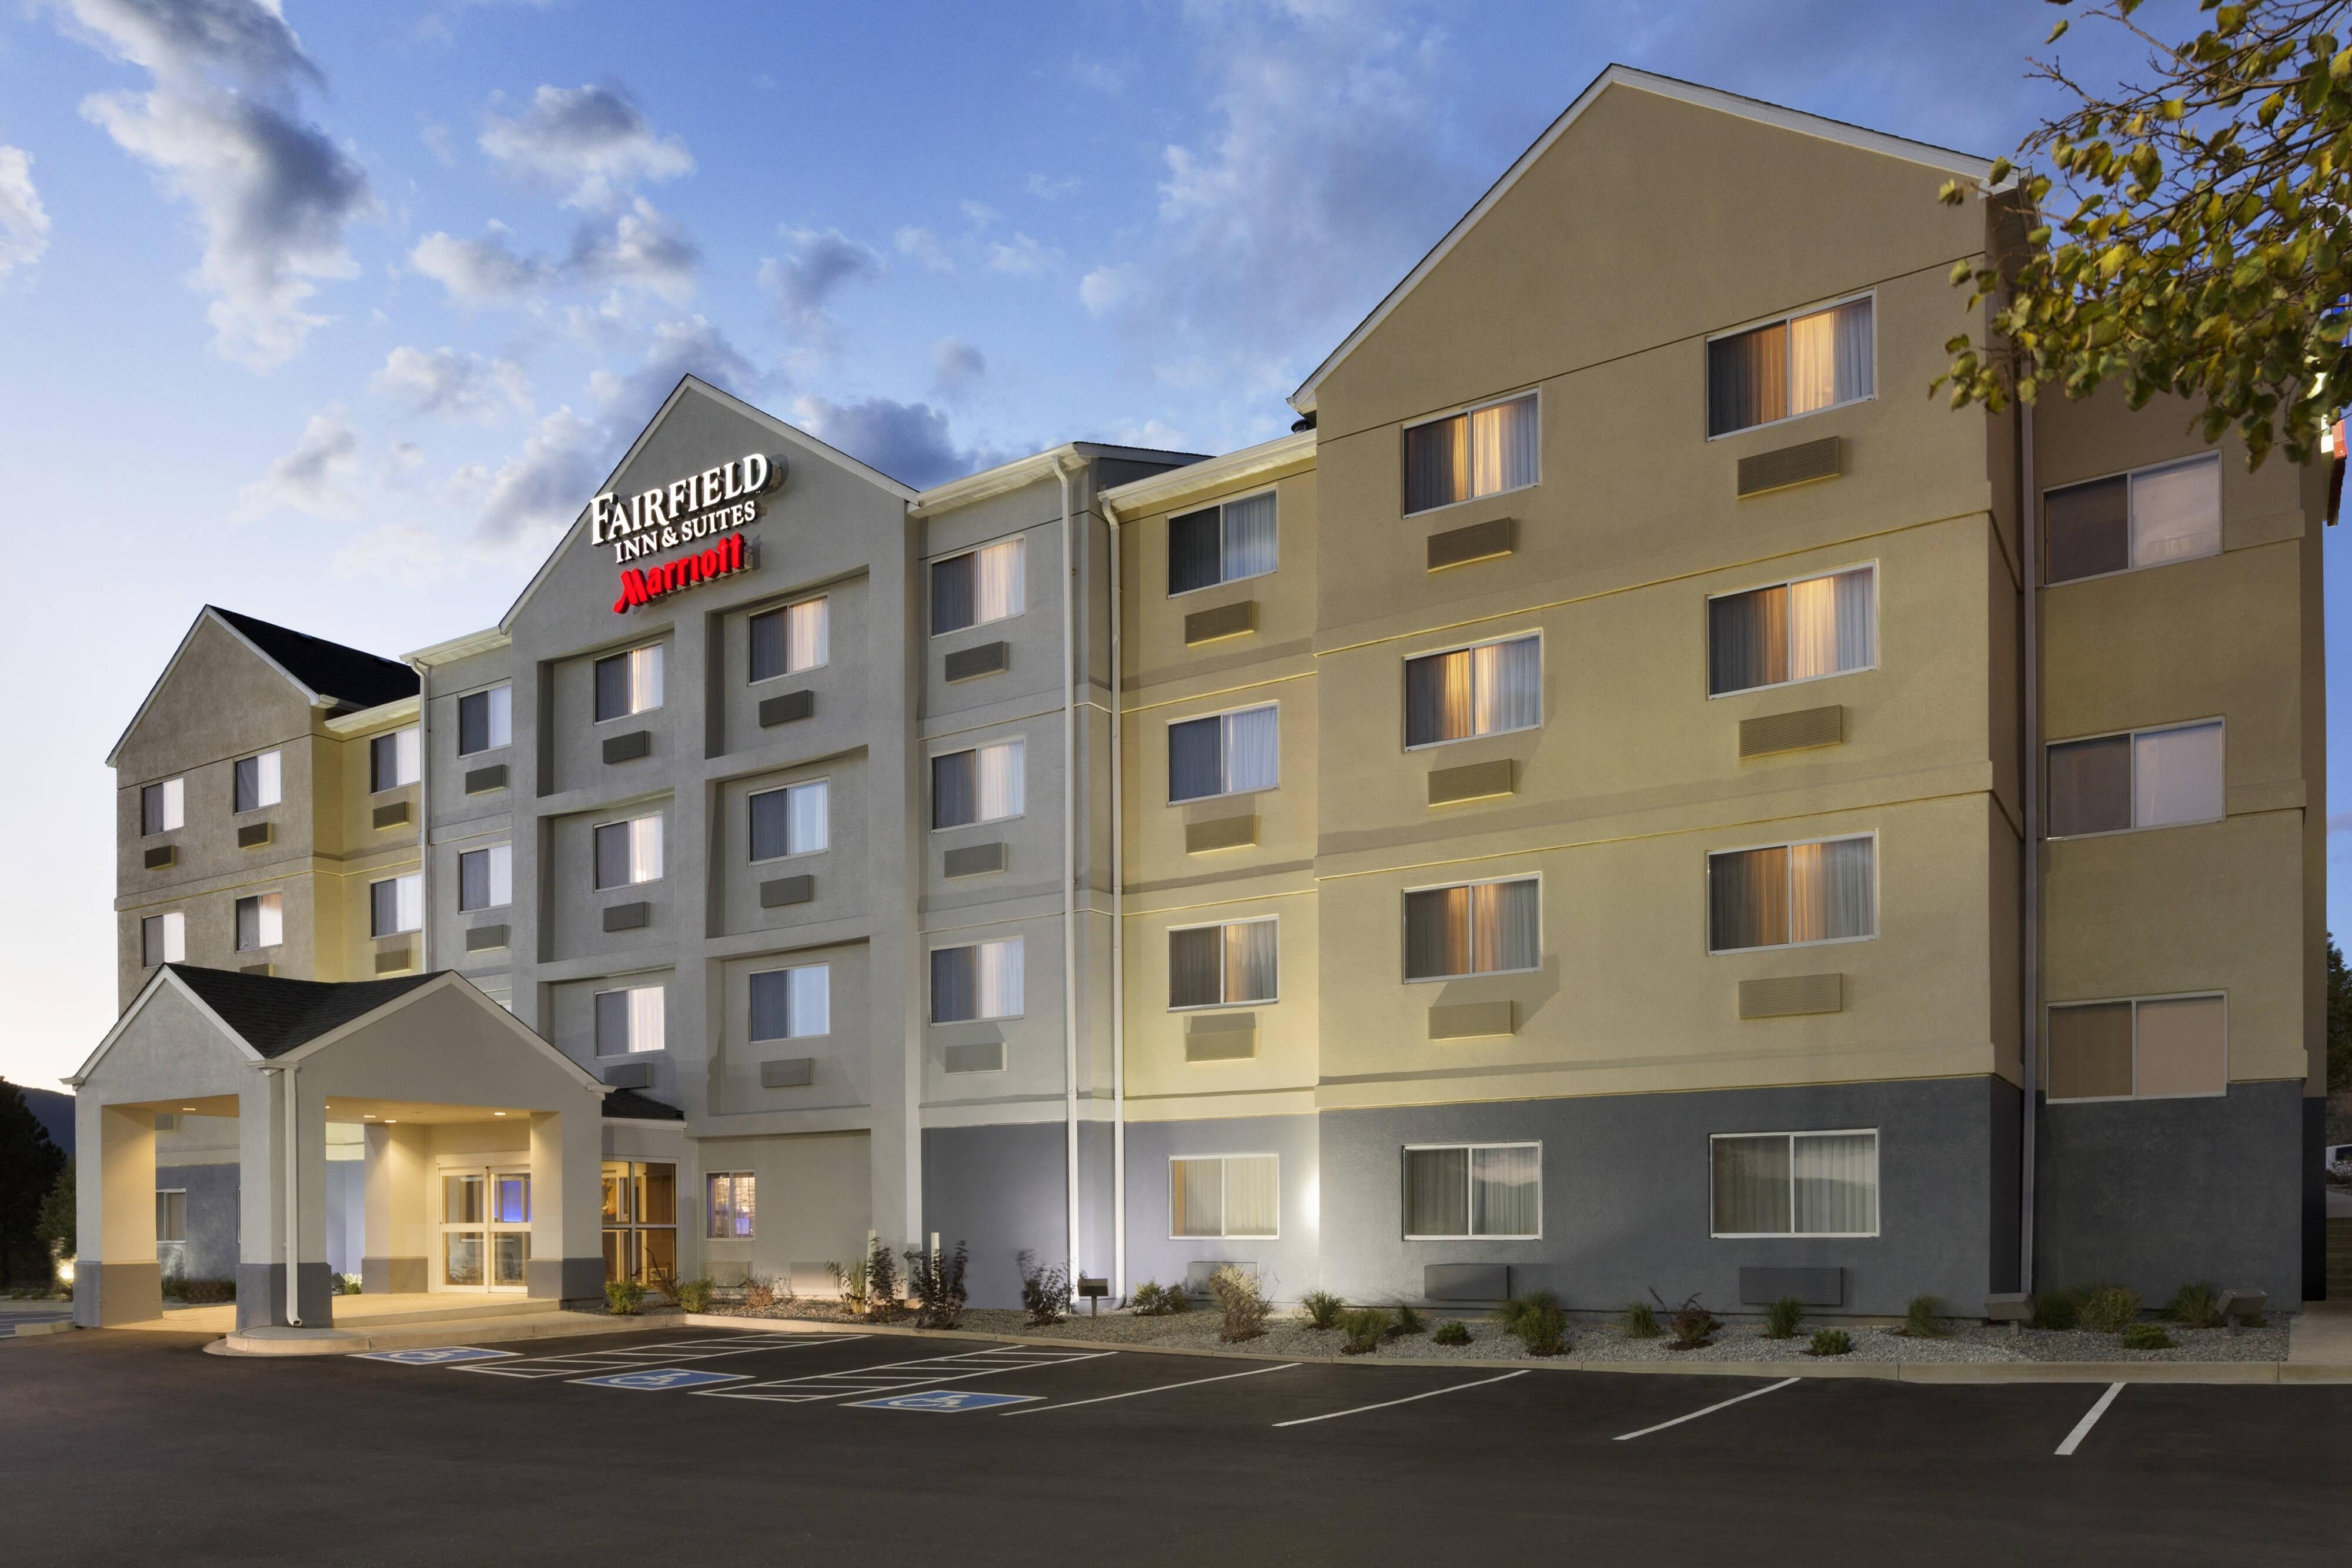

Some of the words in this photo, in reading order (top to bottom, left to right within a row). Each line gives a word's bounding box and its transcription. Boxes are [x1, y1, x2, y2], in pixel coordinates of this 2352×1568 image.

[590, 453, 770, 546] FAIRFIELD
[614, 531, 659, 563] INN
[662, 527, 679, 548] &
[681, 500, 756, 541] SUITES
[613, 532, 745, 614] Marriott
